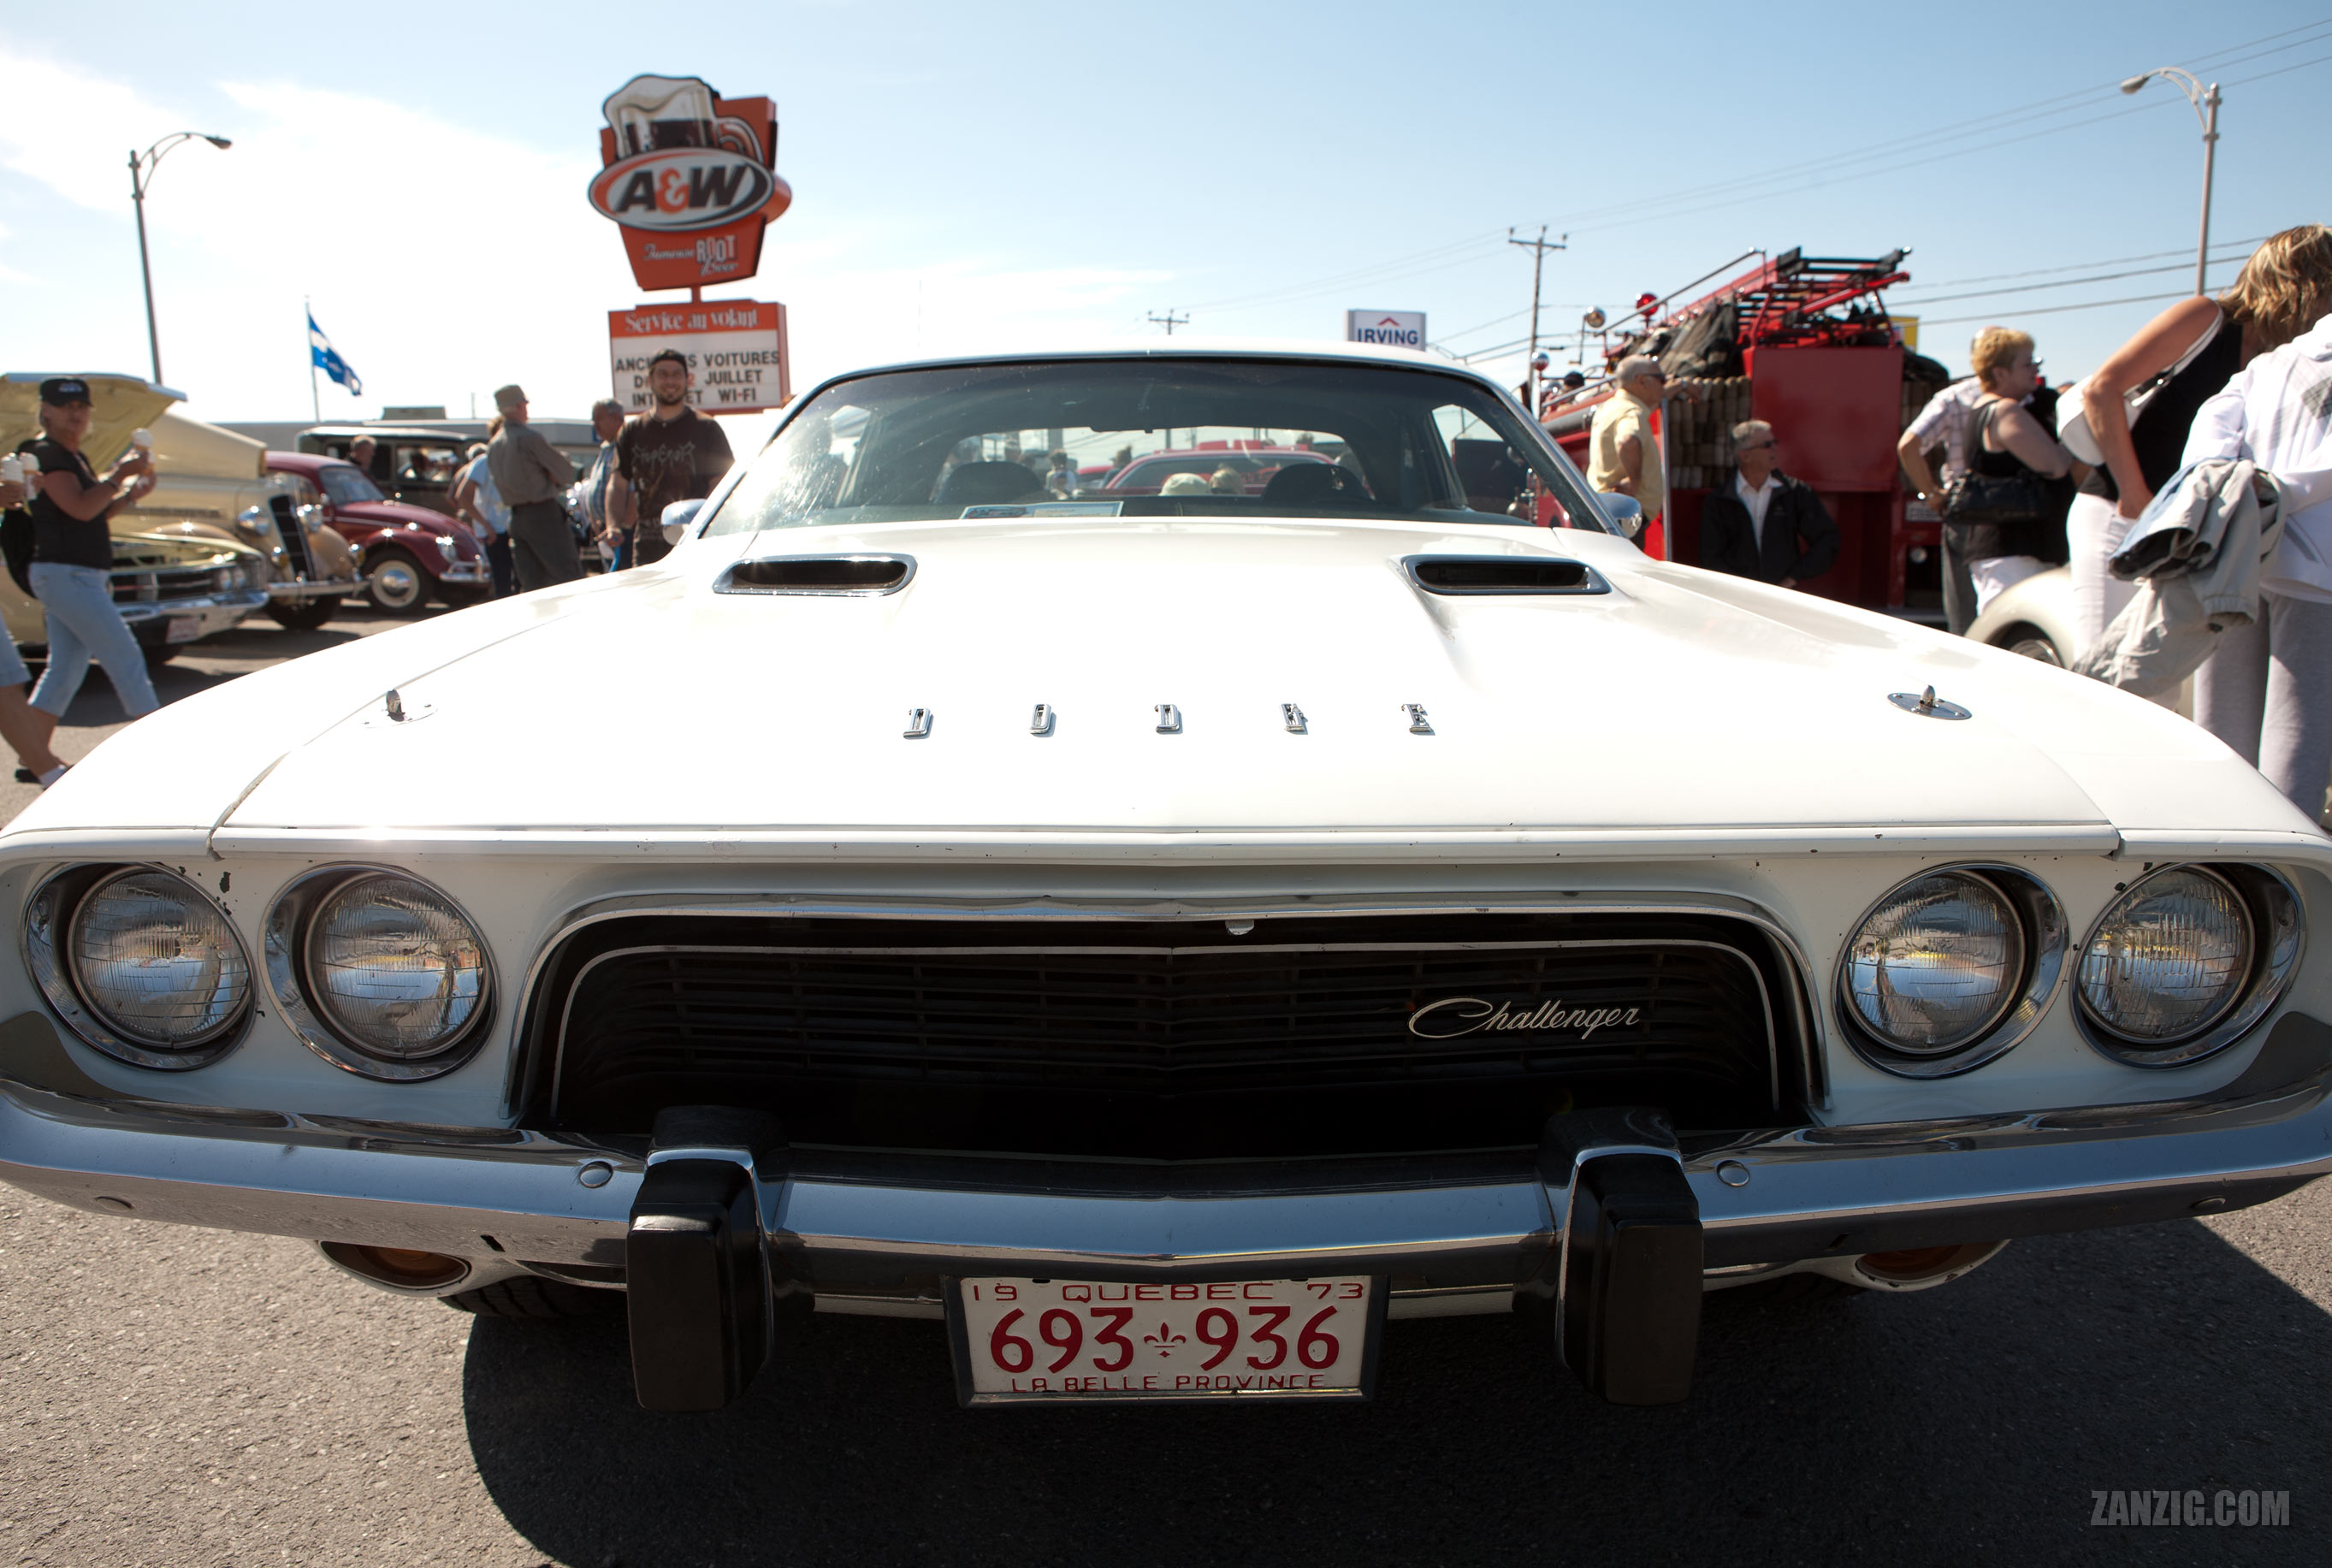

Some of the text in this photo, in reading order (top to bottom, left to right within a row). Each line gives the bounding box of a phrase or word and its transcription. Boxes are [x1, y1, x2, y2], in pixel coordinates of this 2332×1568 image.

[614, 166, 745, 214] A&W
[695, 234, 737, 263] ROOT
[624, 307, 760, 334] Service au volant
[1358, 328, 1419, 345] IRVING
[704, 351, 780, 367] VOITURES
[705, 370, 762, 385] JUILLET
[1409, 997, 1640, 1040] Challenger
[974, 1282, 1364, 1303] 19 QUEBEC 73
[990, 1305, 1340, 1374] 693 936
[1011, 1374, 1326, 1393] LA BELLE PROVINCE
